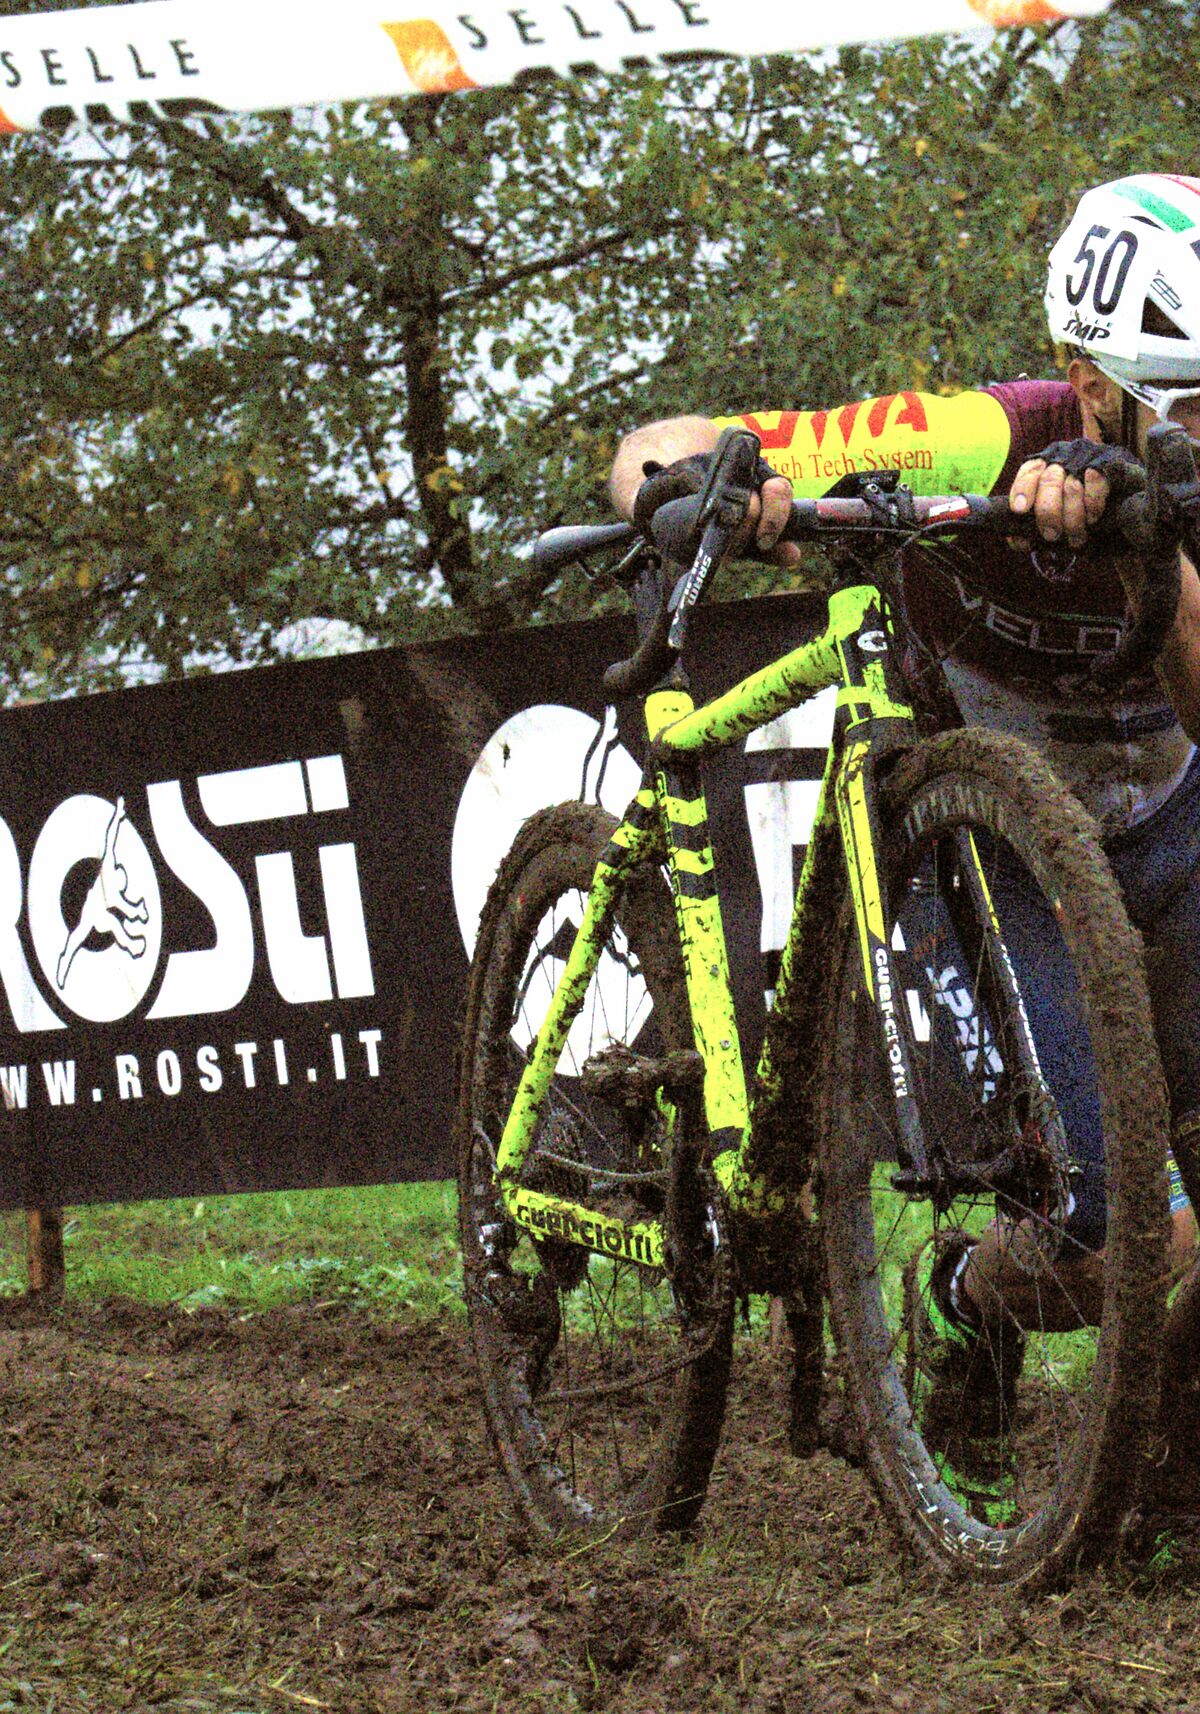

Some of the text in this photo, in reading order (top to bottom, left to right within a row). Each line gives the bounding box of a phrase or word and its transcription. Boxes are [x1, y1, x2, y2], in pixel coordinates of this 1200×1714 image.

[457, 0, 709, 50] SELLE
[0, 39, 200, 88] SELLE
[1066, 224, 1138, 316] 50
[1063, 319, 1110, 341] SMP
[808, 451, 856, 479] Tech
